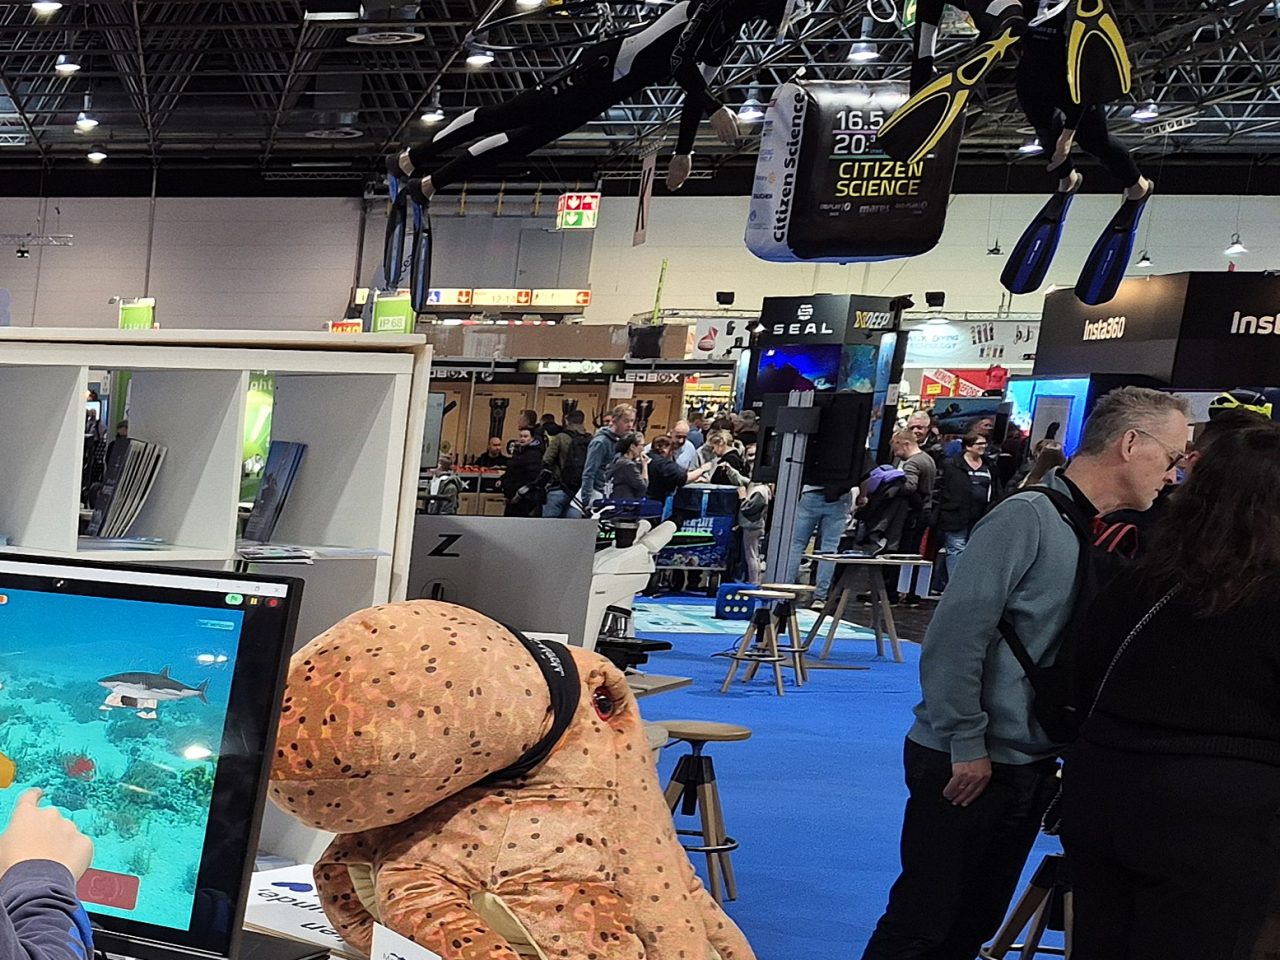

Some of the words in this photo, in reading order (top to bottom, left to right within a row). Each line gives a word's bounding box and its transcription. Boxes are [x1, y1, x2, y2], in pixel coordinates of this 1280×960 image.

[773, 174, 794, 243] Citizen
[784, 92, 805, 169] Science
[839, 161, 924, 178] CITIZEN
[835, 179, 921, 197] SCIENCE
[773, 323, 833, 335] SEAL
[1083, 316, 1127, 341] Insta360
[616, 372, 680, 383] LEDBOX
[427, 533, 463, 557] Z
